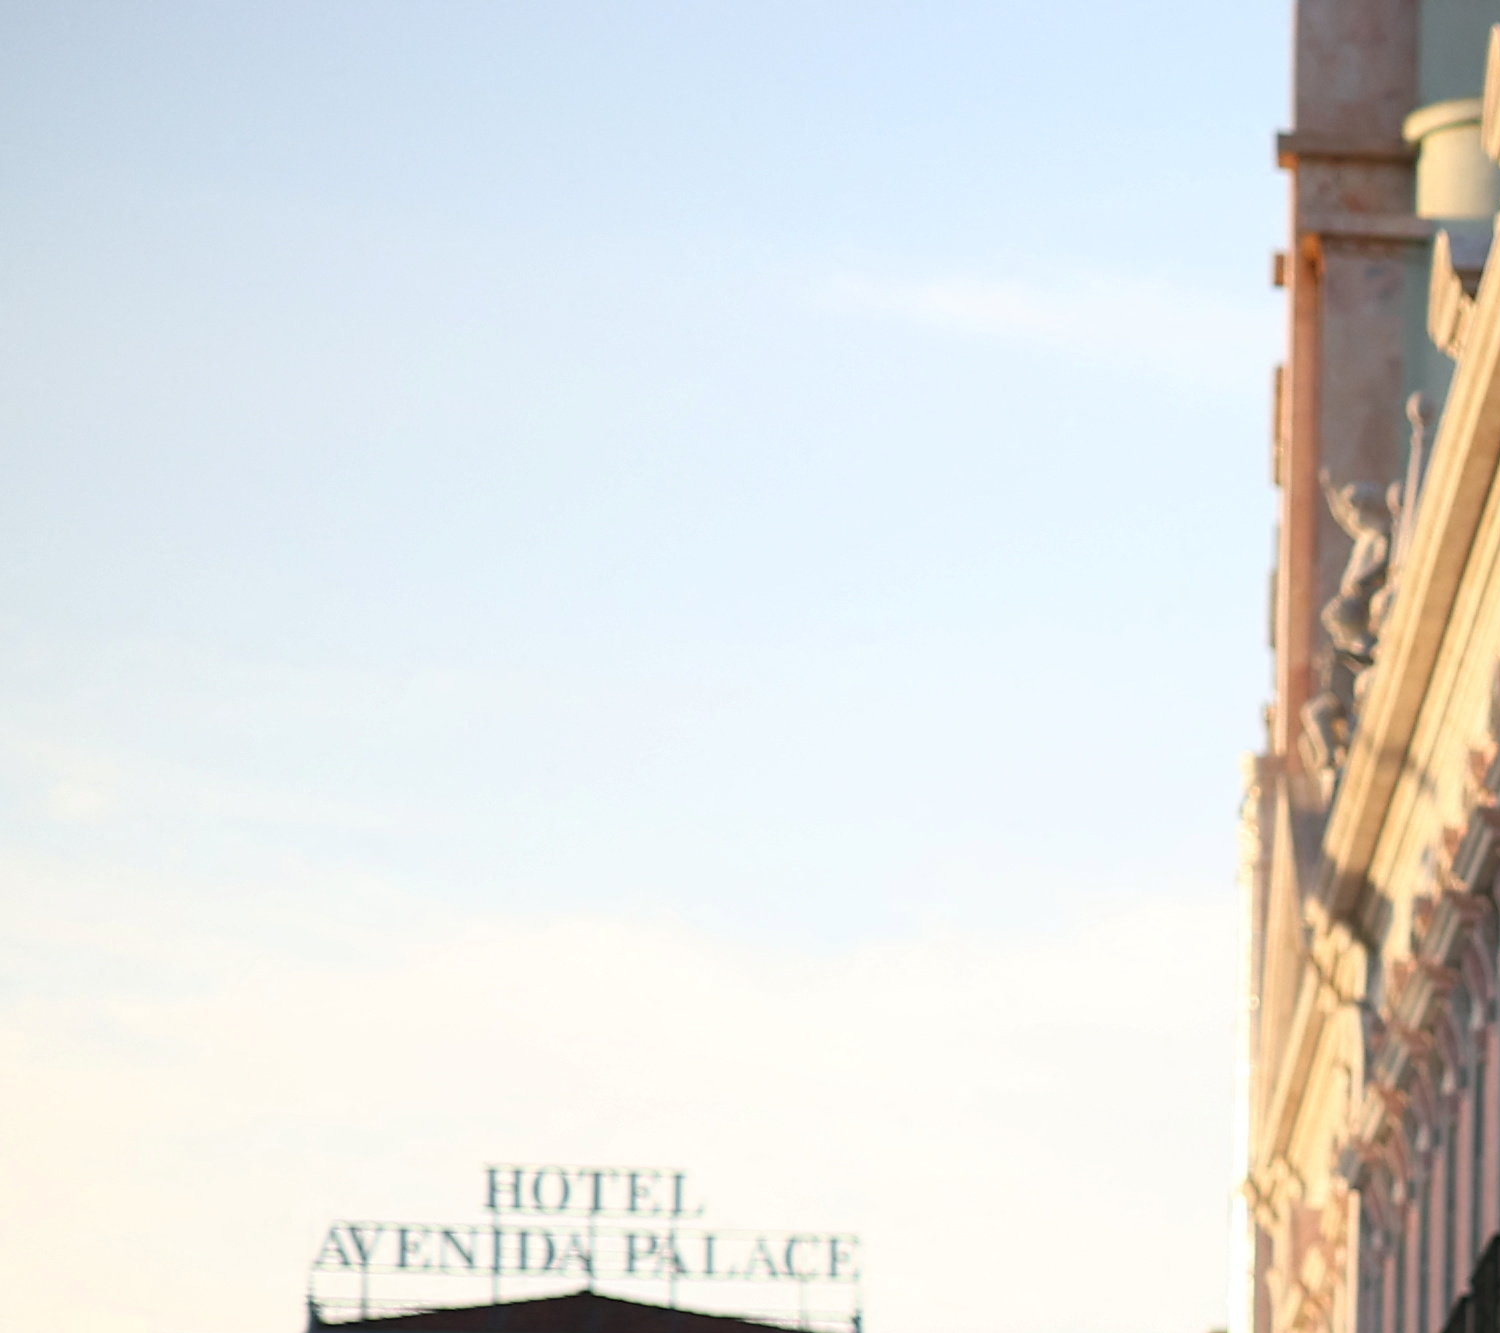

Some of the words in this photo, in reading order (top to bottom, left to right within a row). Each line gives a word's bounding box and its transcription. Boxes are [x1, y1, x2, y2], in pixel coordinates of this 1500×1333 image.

[484, 1165, 704, 1217] HOTEL
[314, 1224, 595, 1275] AVENIDA
[624, 1231, 861, 1281] PALACE
